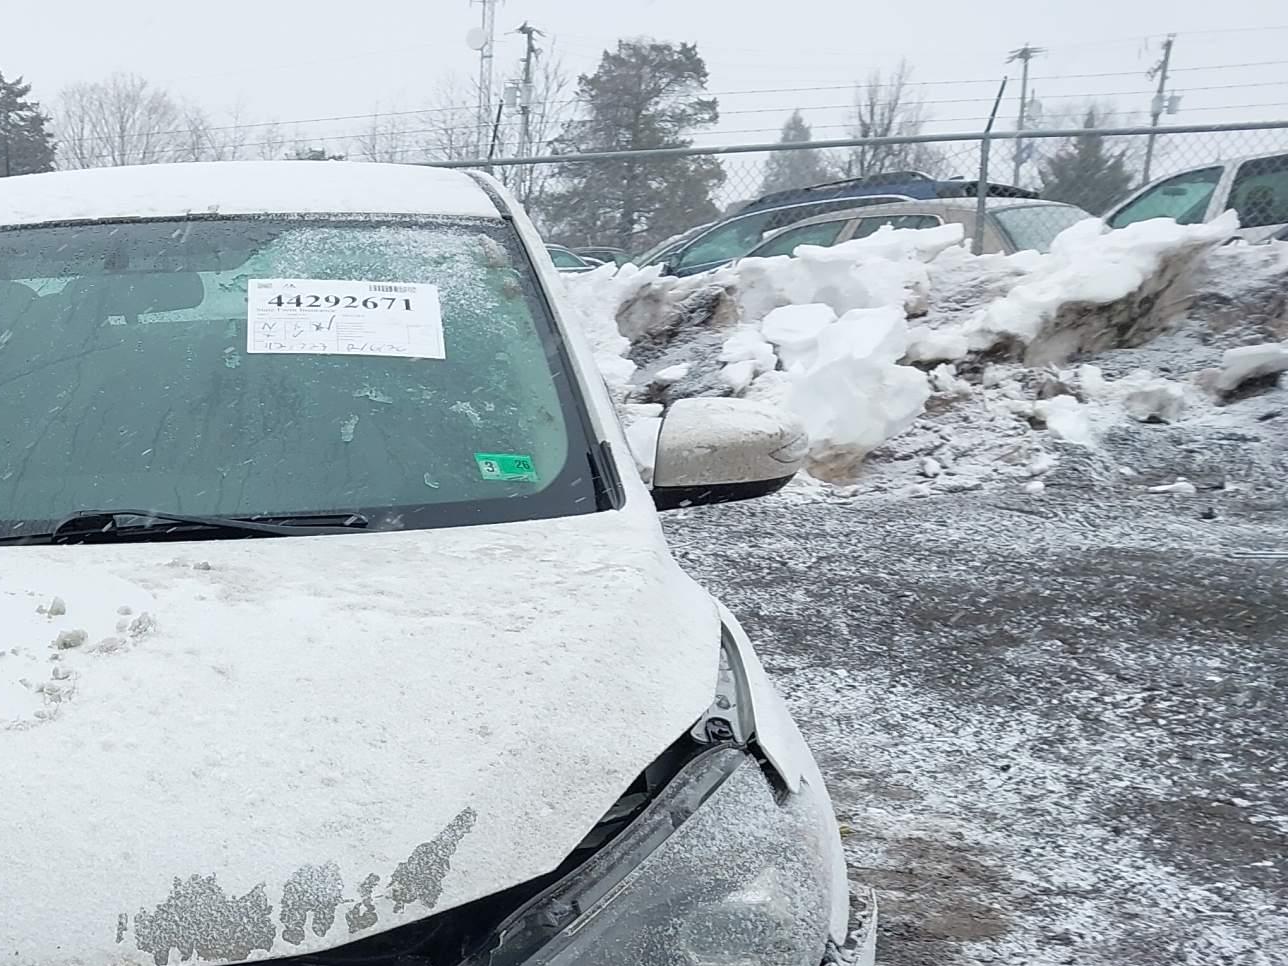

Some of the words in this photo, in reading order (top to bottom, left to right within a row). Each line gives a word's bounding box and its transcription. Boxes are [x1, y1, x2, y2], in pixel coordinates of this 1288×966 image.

[268, 294, 414, 312] 44292671
[484, 461, 495, 473] 3
[514, 459, 530, 470] 26
